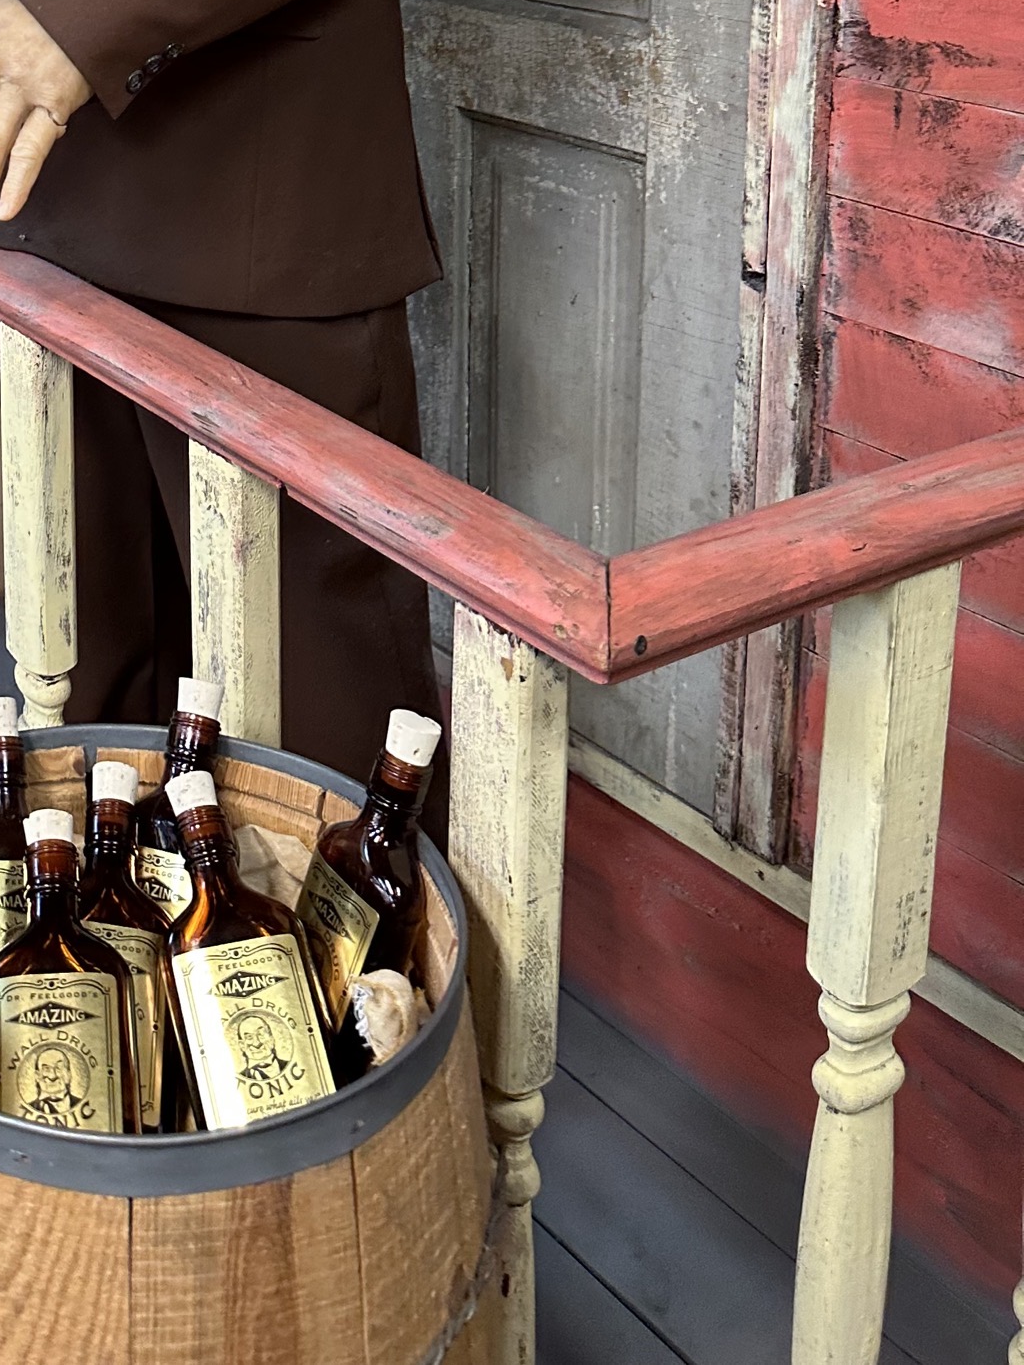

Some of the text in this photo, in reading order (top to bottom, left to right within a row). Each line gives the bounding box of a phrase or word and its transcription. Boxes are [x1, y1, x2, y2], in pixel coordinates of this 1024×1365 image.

[218, 955, 283, 972] FEELGOOD'S
[212, 974, 277, 996] AMAZING
[6, 990, 99, 1003] DR. FEELGOOD'S
[18, 1008, 86, 1024] AMAZING
[220, 997, 297, 1029] ALL DRUG
[8, 1029, 99, 1071] WALL DRUG
[235, 1062, 306, 1100] TONIC
